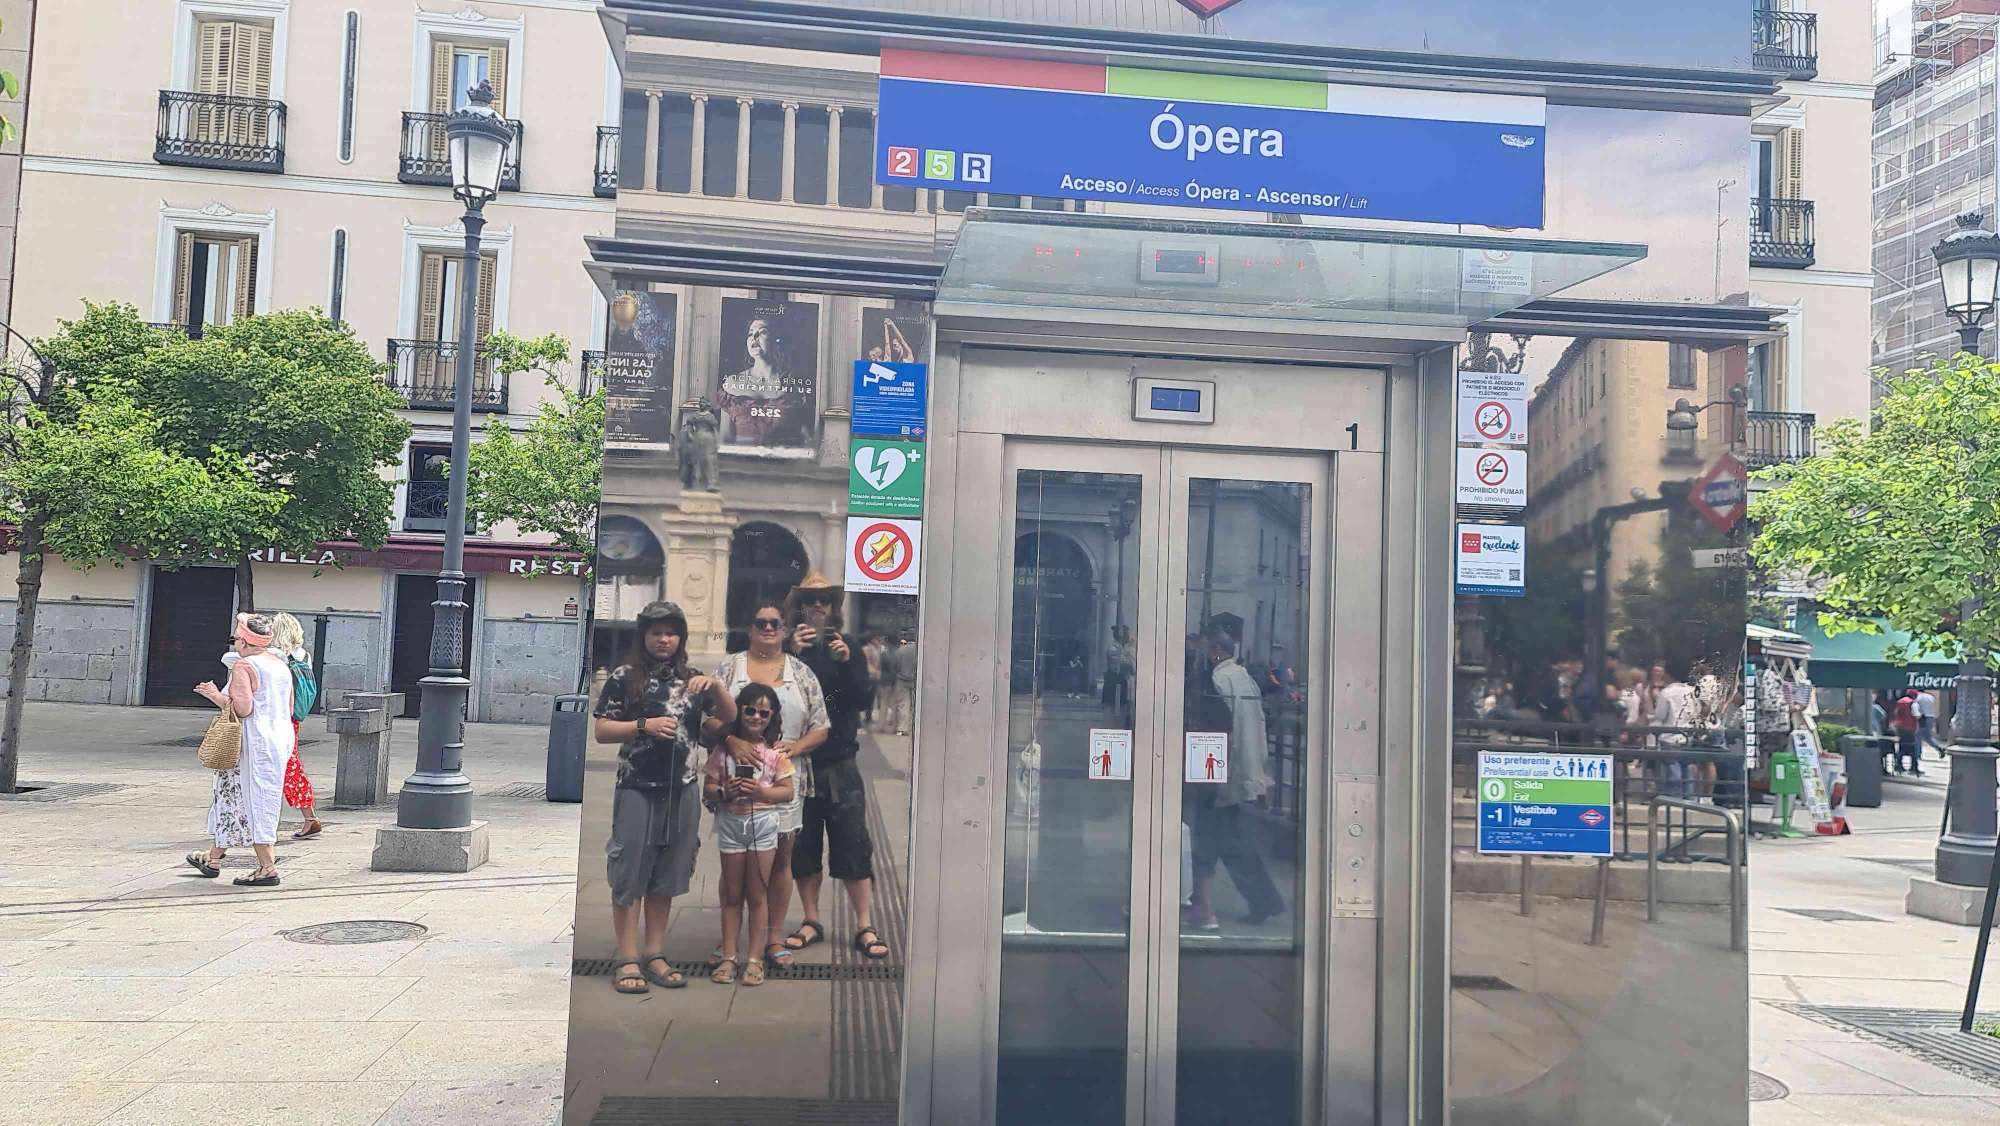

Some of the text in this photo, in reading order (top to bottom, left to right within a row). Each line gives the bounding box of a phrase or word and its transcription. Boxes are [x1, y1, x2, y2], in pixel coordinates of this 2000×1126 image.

[1149, 103, 1285, 162] Ópera
[894, 150, 986, 179] 2 5 R
[1185, 176, 1240, 205] Ópera
[1345, 423, 1358, 450] 1
[1460, 486, 1524, 495] PROHIBIDO FUMAR
[1483, 540, 1521, 552] excelente
[1484, 755, 1551, 766] Uso preferente
[1483, 767, 1549, 777] Preferential use
[1490, 783, 1499, 797] 0
[1513, 780, 1544, 790] Salida
[1513, 792, 1530, 801] Exit
[1487, 808, 1502, 822] -1
[1513, 817, 1532, 827] Hall
